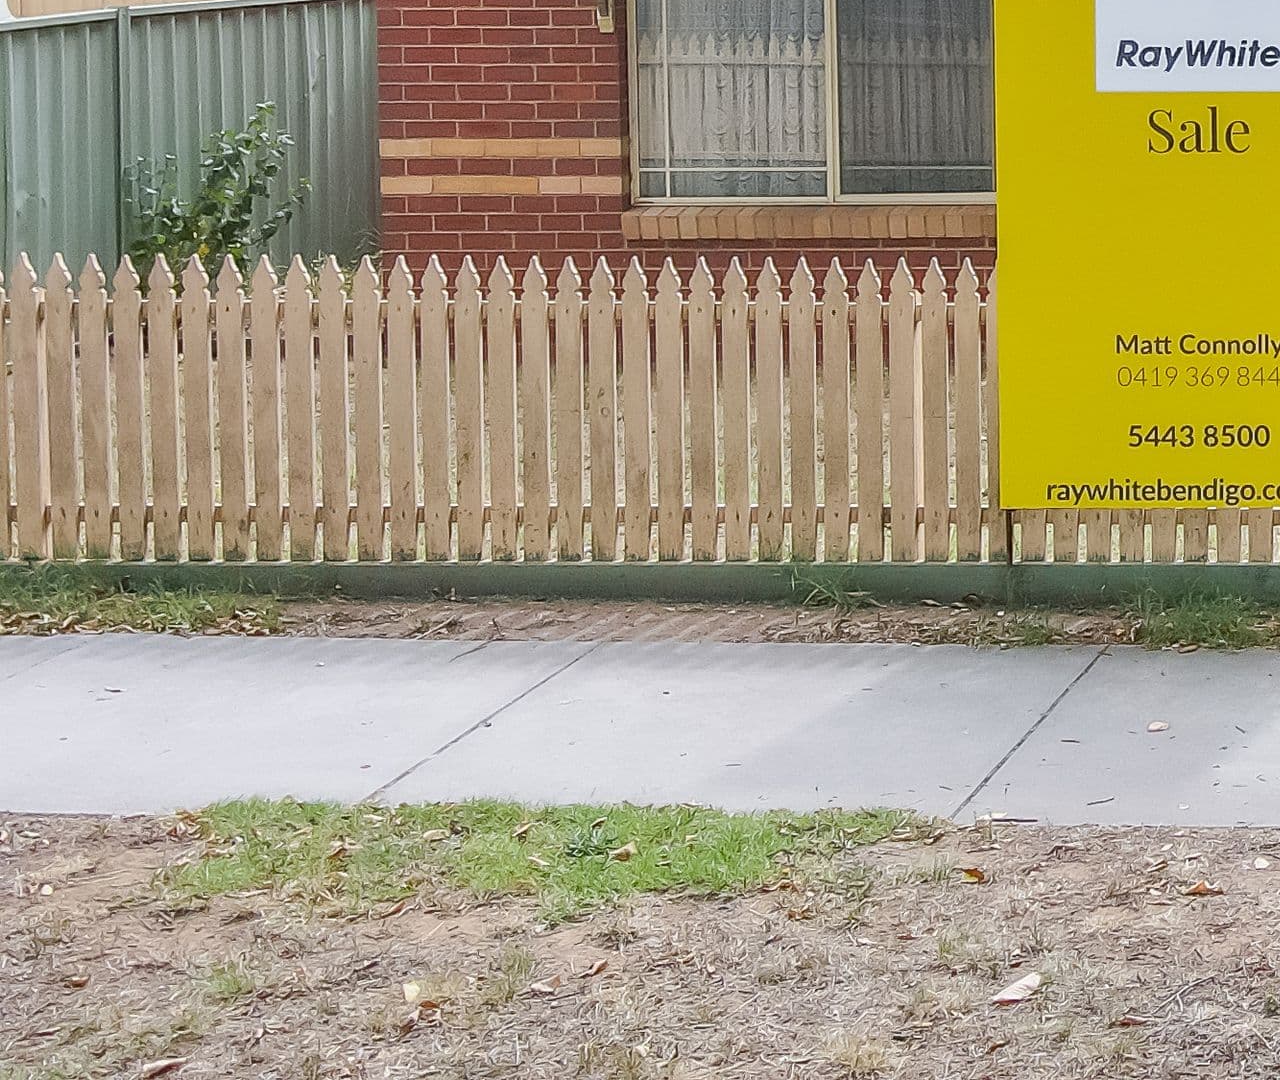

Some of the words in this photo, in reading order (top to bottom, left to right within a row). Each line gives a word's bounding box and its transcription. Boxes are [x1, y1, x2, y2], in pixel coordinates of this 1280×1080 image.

[1147, 105, 1251, 155] Sale
[1115, 334, 1172, 356] Matt
[1116, 365, 1179, 388] 0419
[1184, 365, 1231, 388] 369
[1128, 424, 1195, 448] 5443
[1202, 424, 1271, 448] 8500
